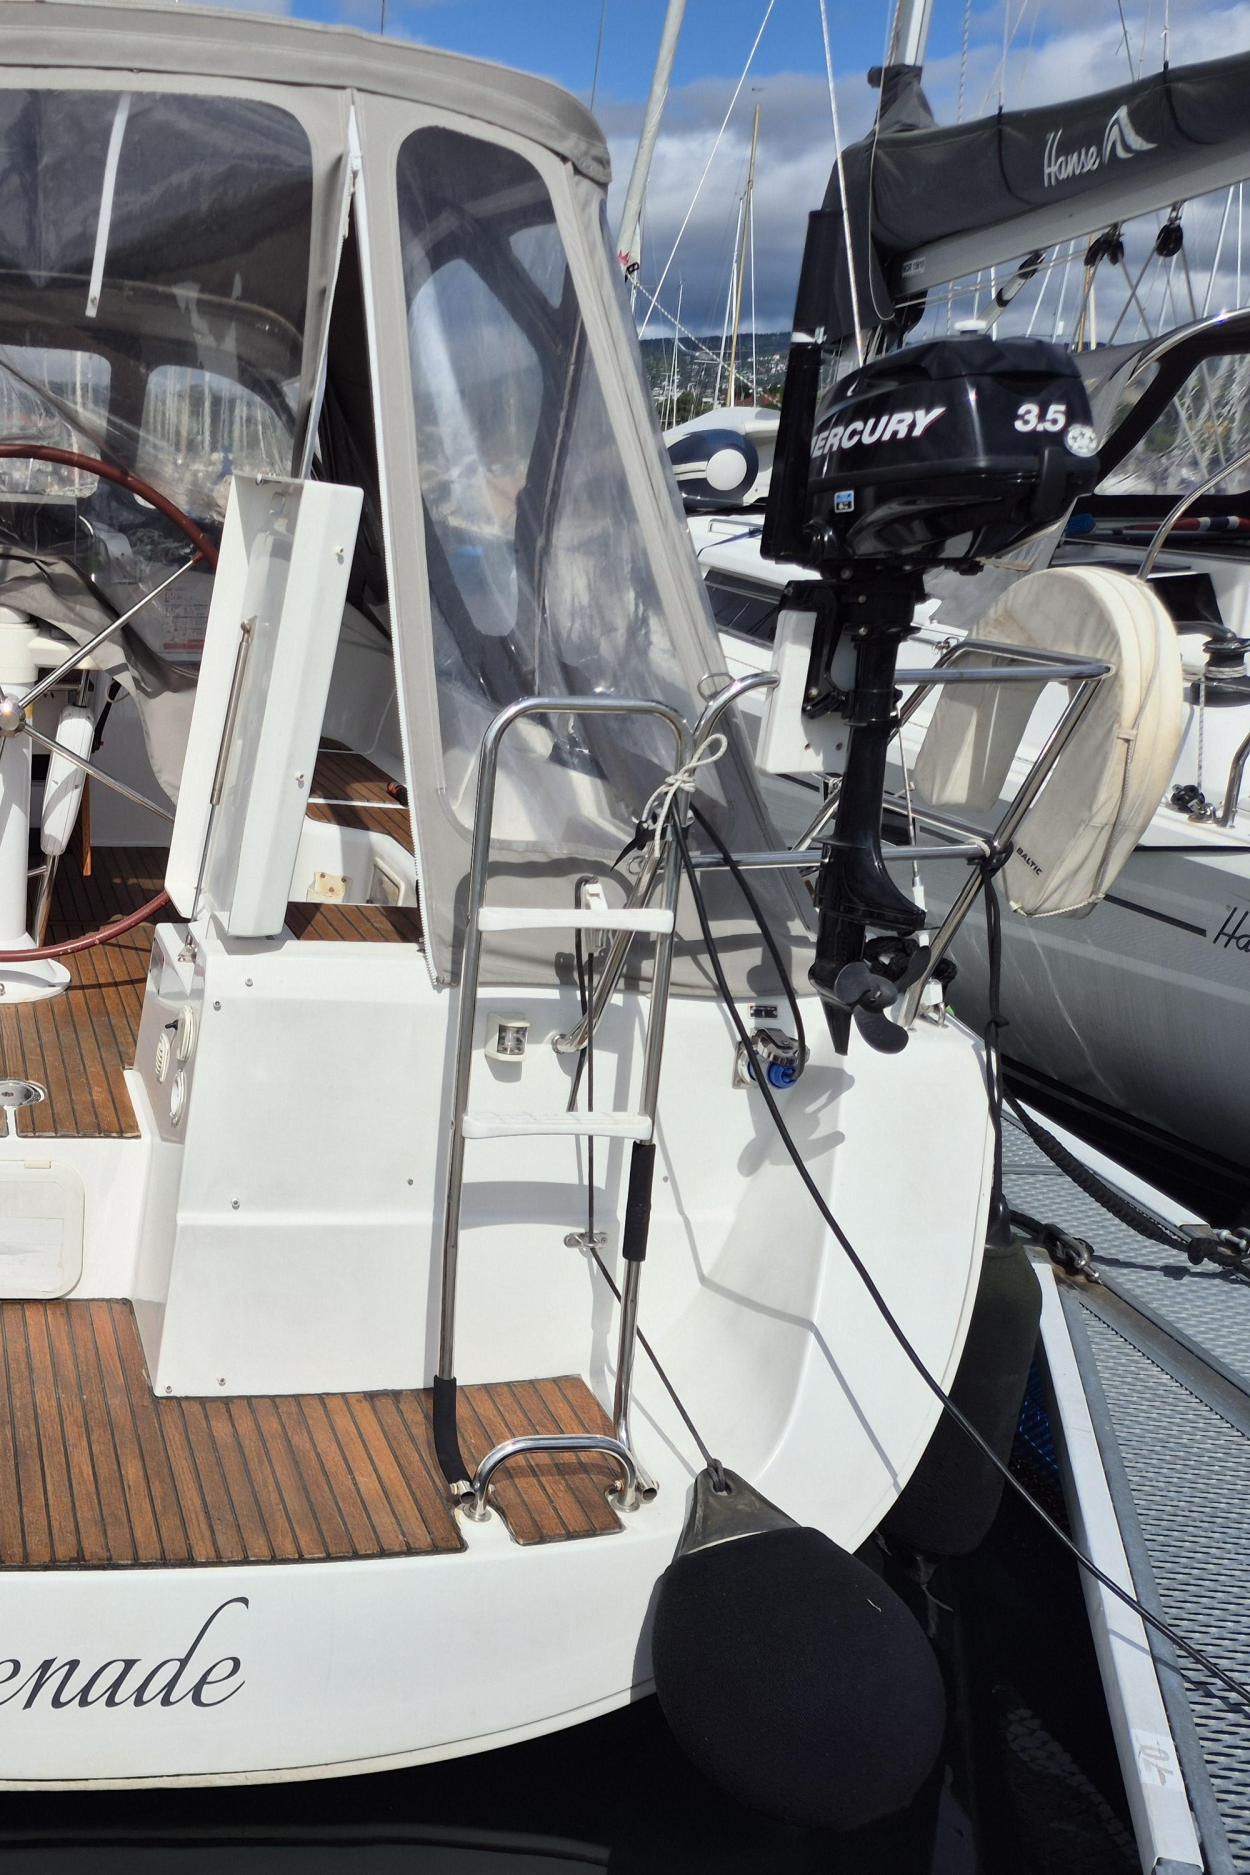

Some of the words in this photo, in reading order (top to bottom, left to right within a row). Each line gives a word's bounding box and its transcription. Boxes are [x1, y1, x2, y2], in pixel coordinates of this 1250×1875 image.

[1044, 128, 1100, 188] Hanse
[1014, 403, 1067, 432] 3.5
[1016, 847, 1043, 875] BALTIC
